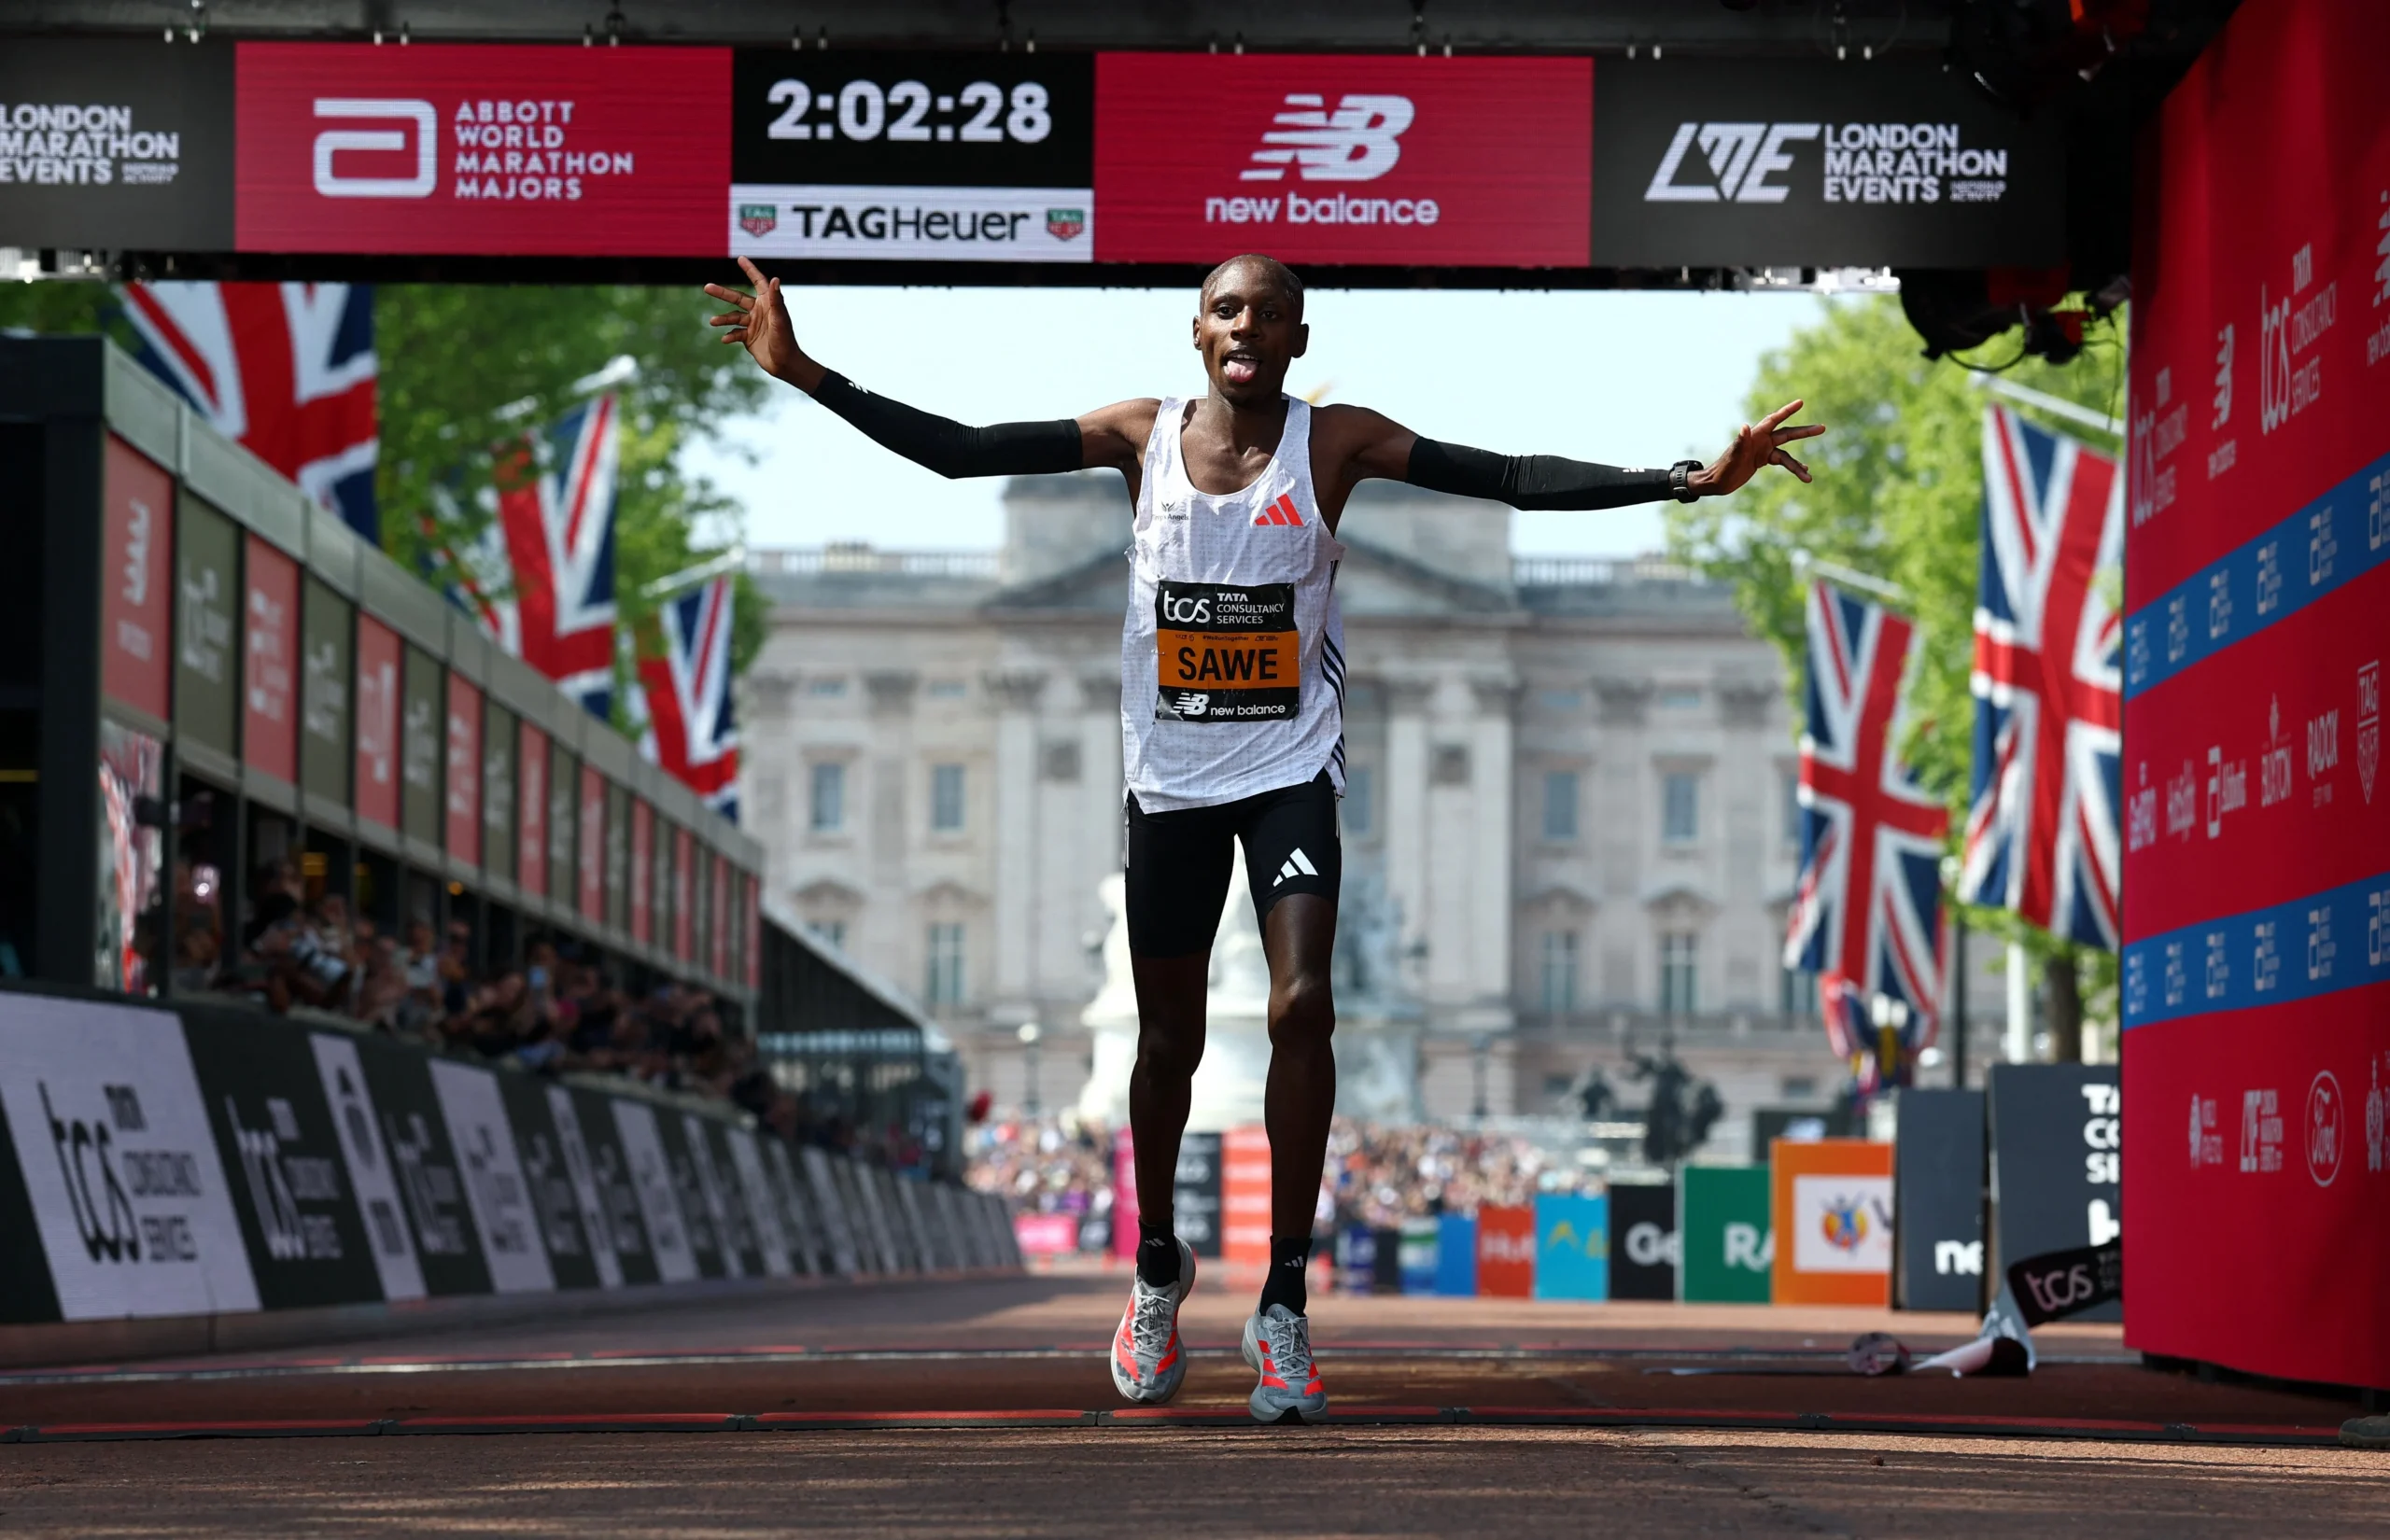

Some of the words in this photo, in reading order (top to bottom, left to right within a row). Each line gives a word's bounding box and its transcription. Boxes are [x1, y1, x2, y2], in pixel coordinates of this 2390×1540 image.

[0, 104, 132, 131] LONDON
[455, 101, 575, 124] ABBOTT
[766, 79, 1051, 143] 2:02:28
[0, 130, 179, 159] MARATHON
[455, 125, 565, 148] WORLD
[1823, 123, 1959, 150] LONDON
[0, 158, 113, 185] EVENTS
[455, 151, 634, 175] MARATHON
[1823, 148, 2007, 177] MARATHON
[455, 176, 583, 200] MAJORS
[1823, 175, 1940, 203] EVENTS
[1205, 197, 1281, 224] new
[1287, 191, 1440, 225] balance
[792, 205, 1030, 242] TAGHeuer
[1168, 513, 1189, 522] Angels
[1163, 590, 1211, 623] tcs
[1216, 593, 1248, 602] TATA
[1216, 603, 1285, 614] CONSULTANCY
[1216, 615, 1264, 624] SERVICES
[1177, 646, 1278, 681] SAWE
[1210, 706, 1234, 716] new
[1237, 705, 1286, 716] balance
[2307, 708, 2339, 780] RADOX
[2024, 1263, 2094, 1312] tcs
